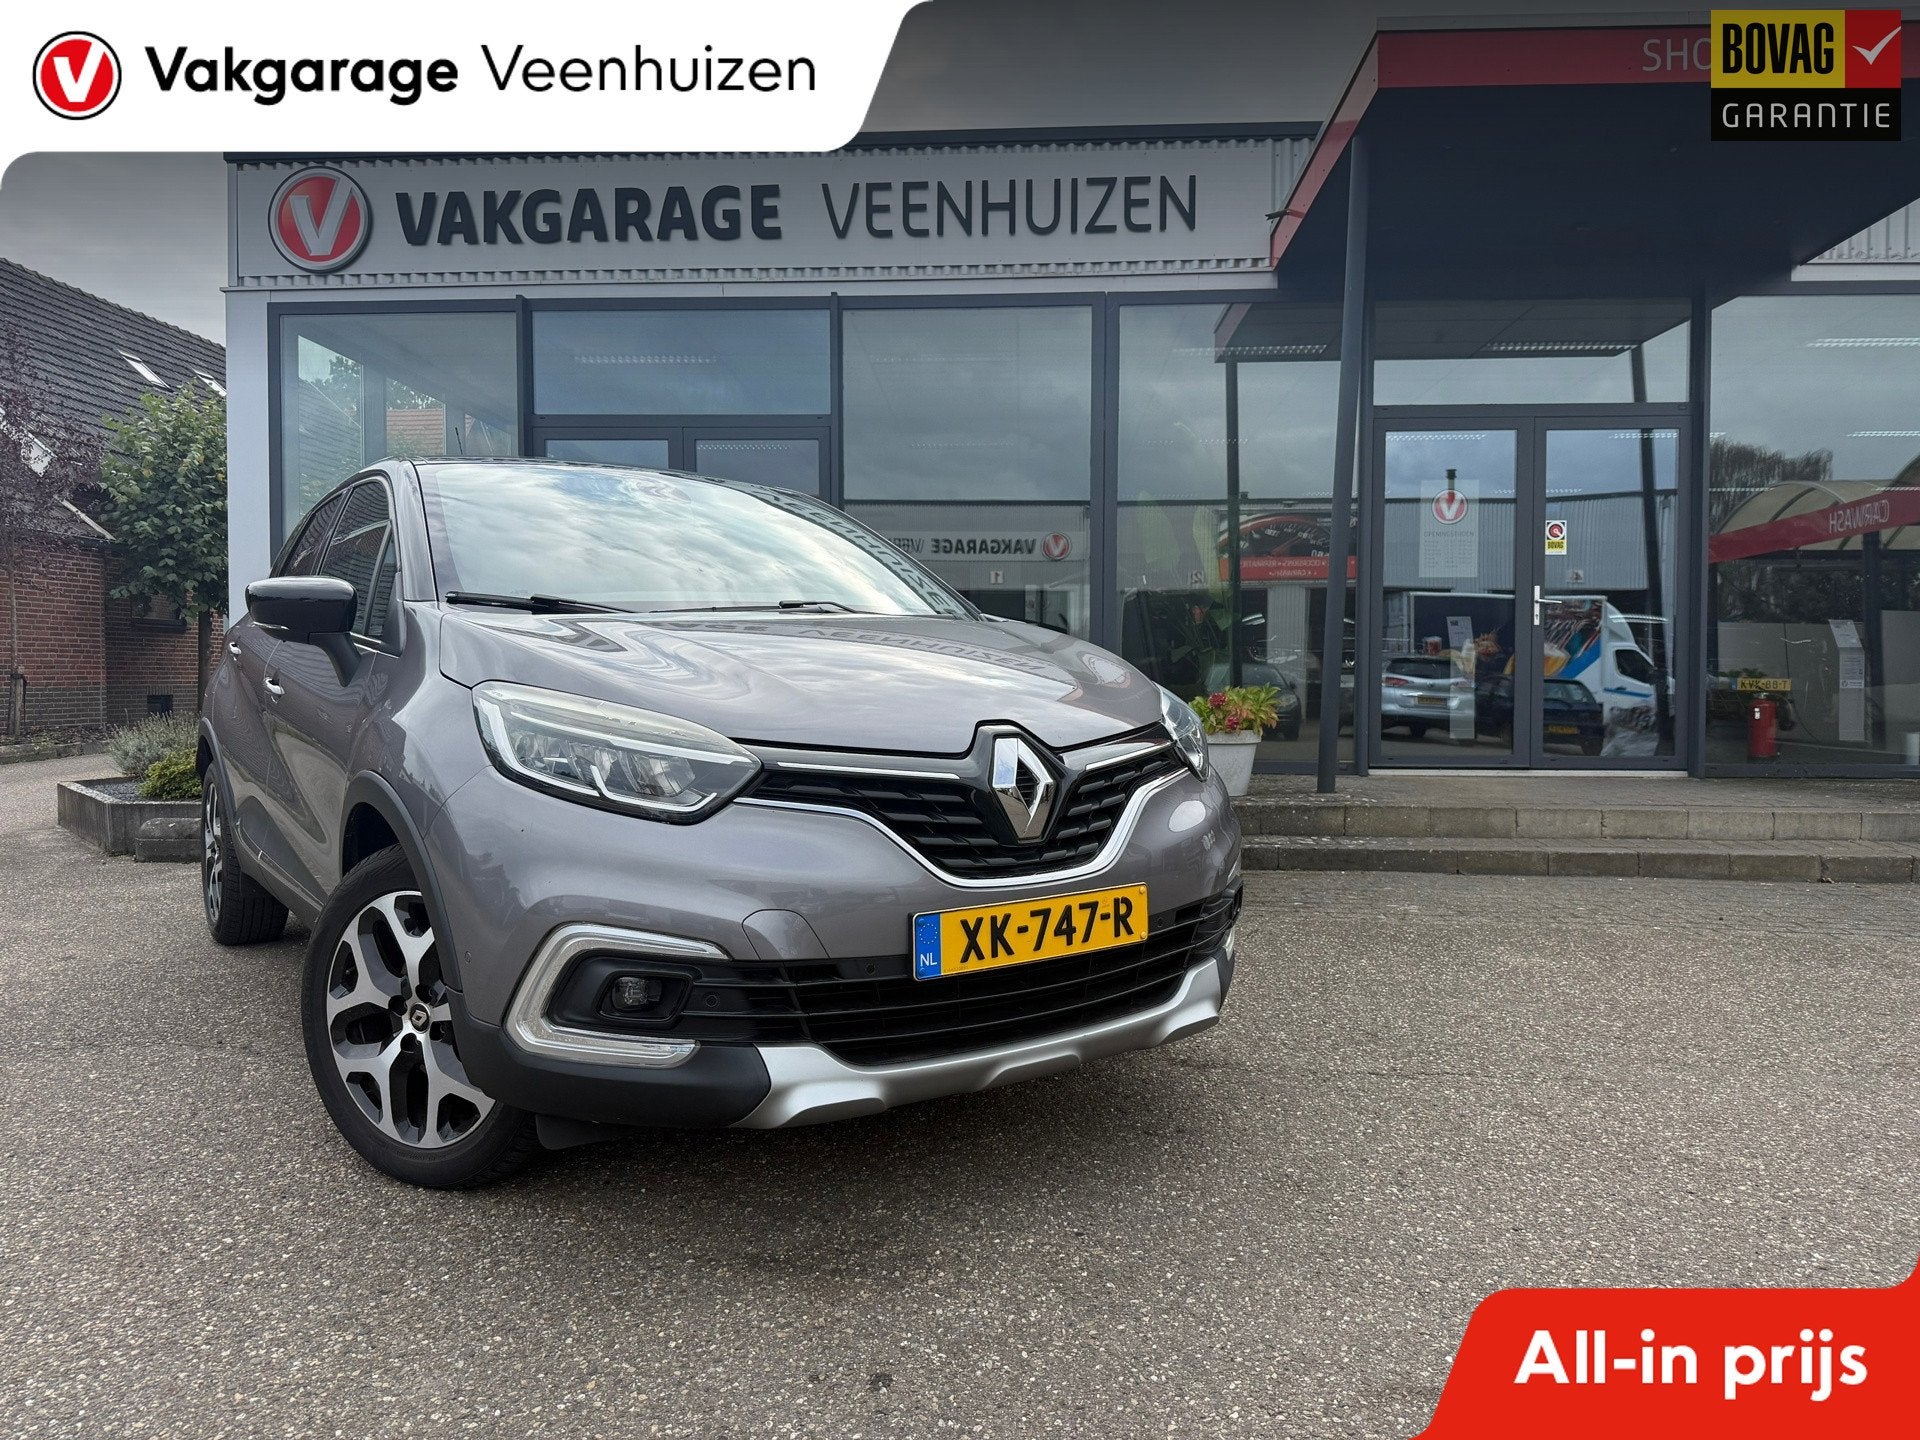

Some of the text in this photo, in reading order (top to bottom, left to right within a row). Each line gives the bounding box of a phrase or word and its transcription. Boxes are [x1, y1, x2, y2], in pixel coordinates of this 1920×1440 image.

[396, 174, 1197, 246] VAKGARAGE VEENHUIZEN
[920, 953, 938, 967] NL
[960, 896, 1134, 963] XK-747-R
